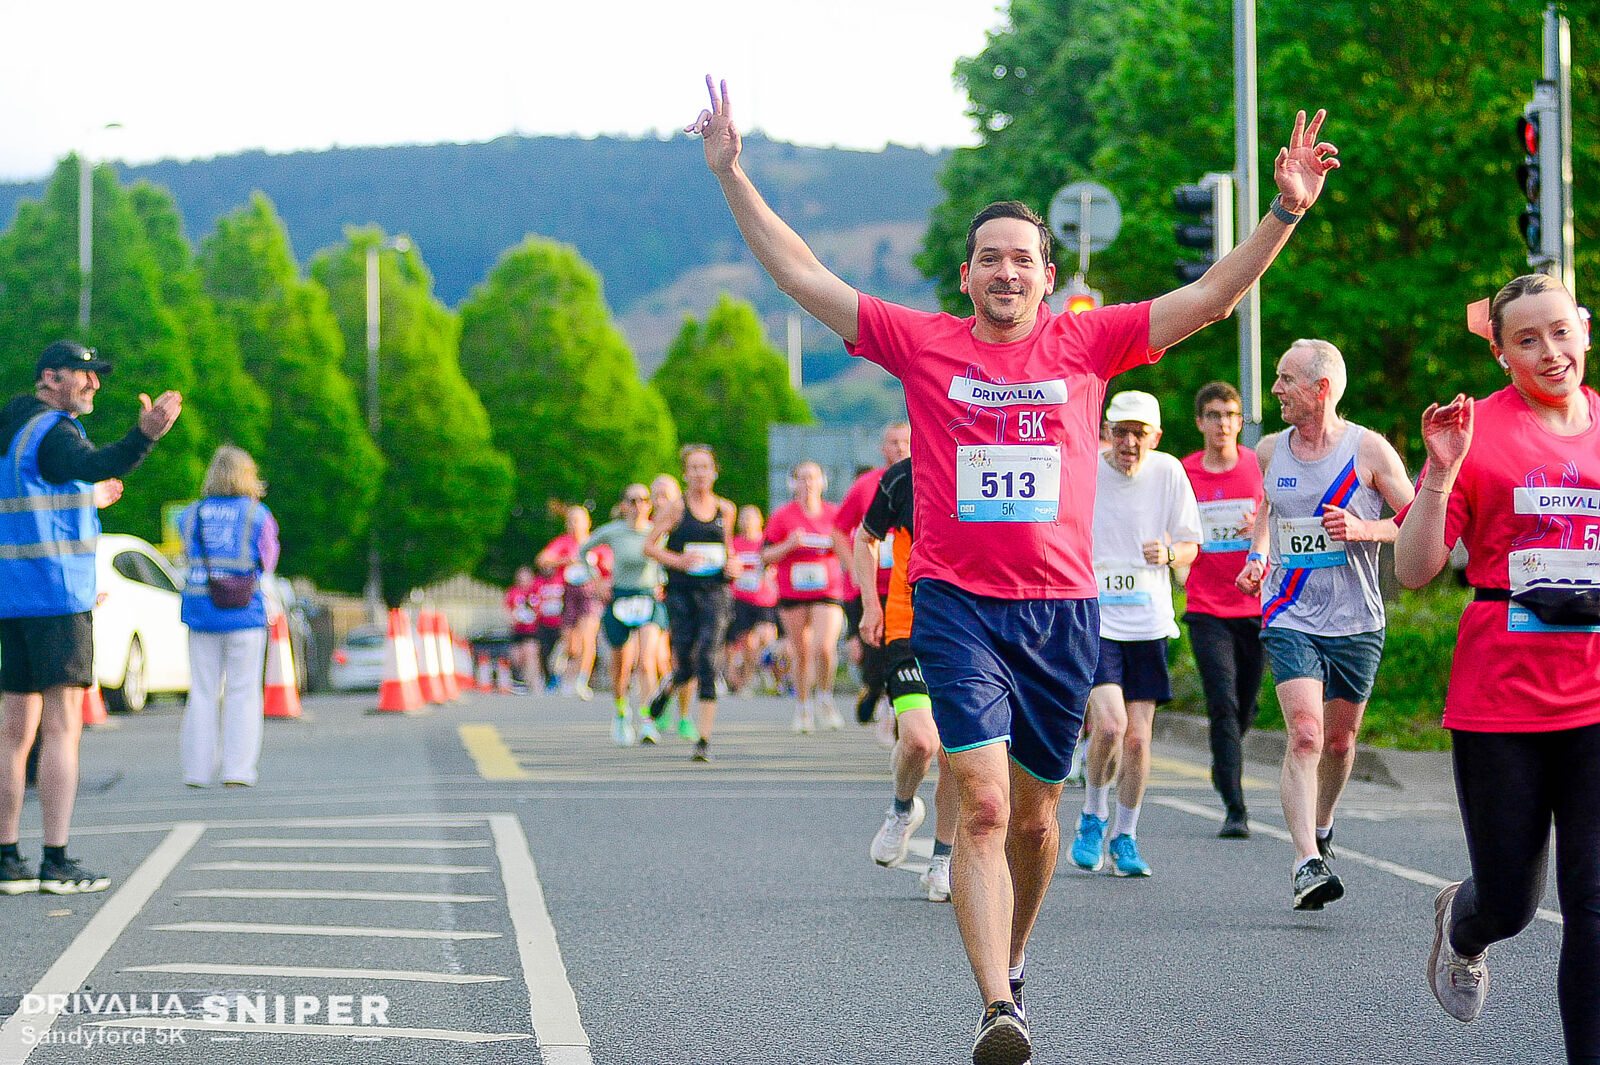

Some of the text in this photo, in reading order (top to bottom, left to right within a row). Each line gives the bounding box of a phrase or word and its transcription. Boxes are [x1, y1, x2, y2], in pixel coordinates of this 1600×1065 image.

[971, 387, 1045, 402] DRIVALIA
[1018, 411, 1046, 438] 5K
[981, 471, 1036, 498] 513
[1002, 503, 1015, 515] 5K
[1291, 535, 1327, 554] 624
[1584, 525, 1600, 550] 5
[1105, 575, 1135, 590] 130
